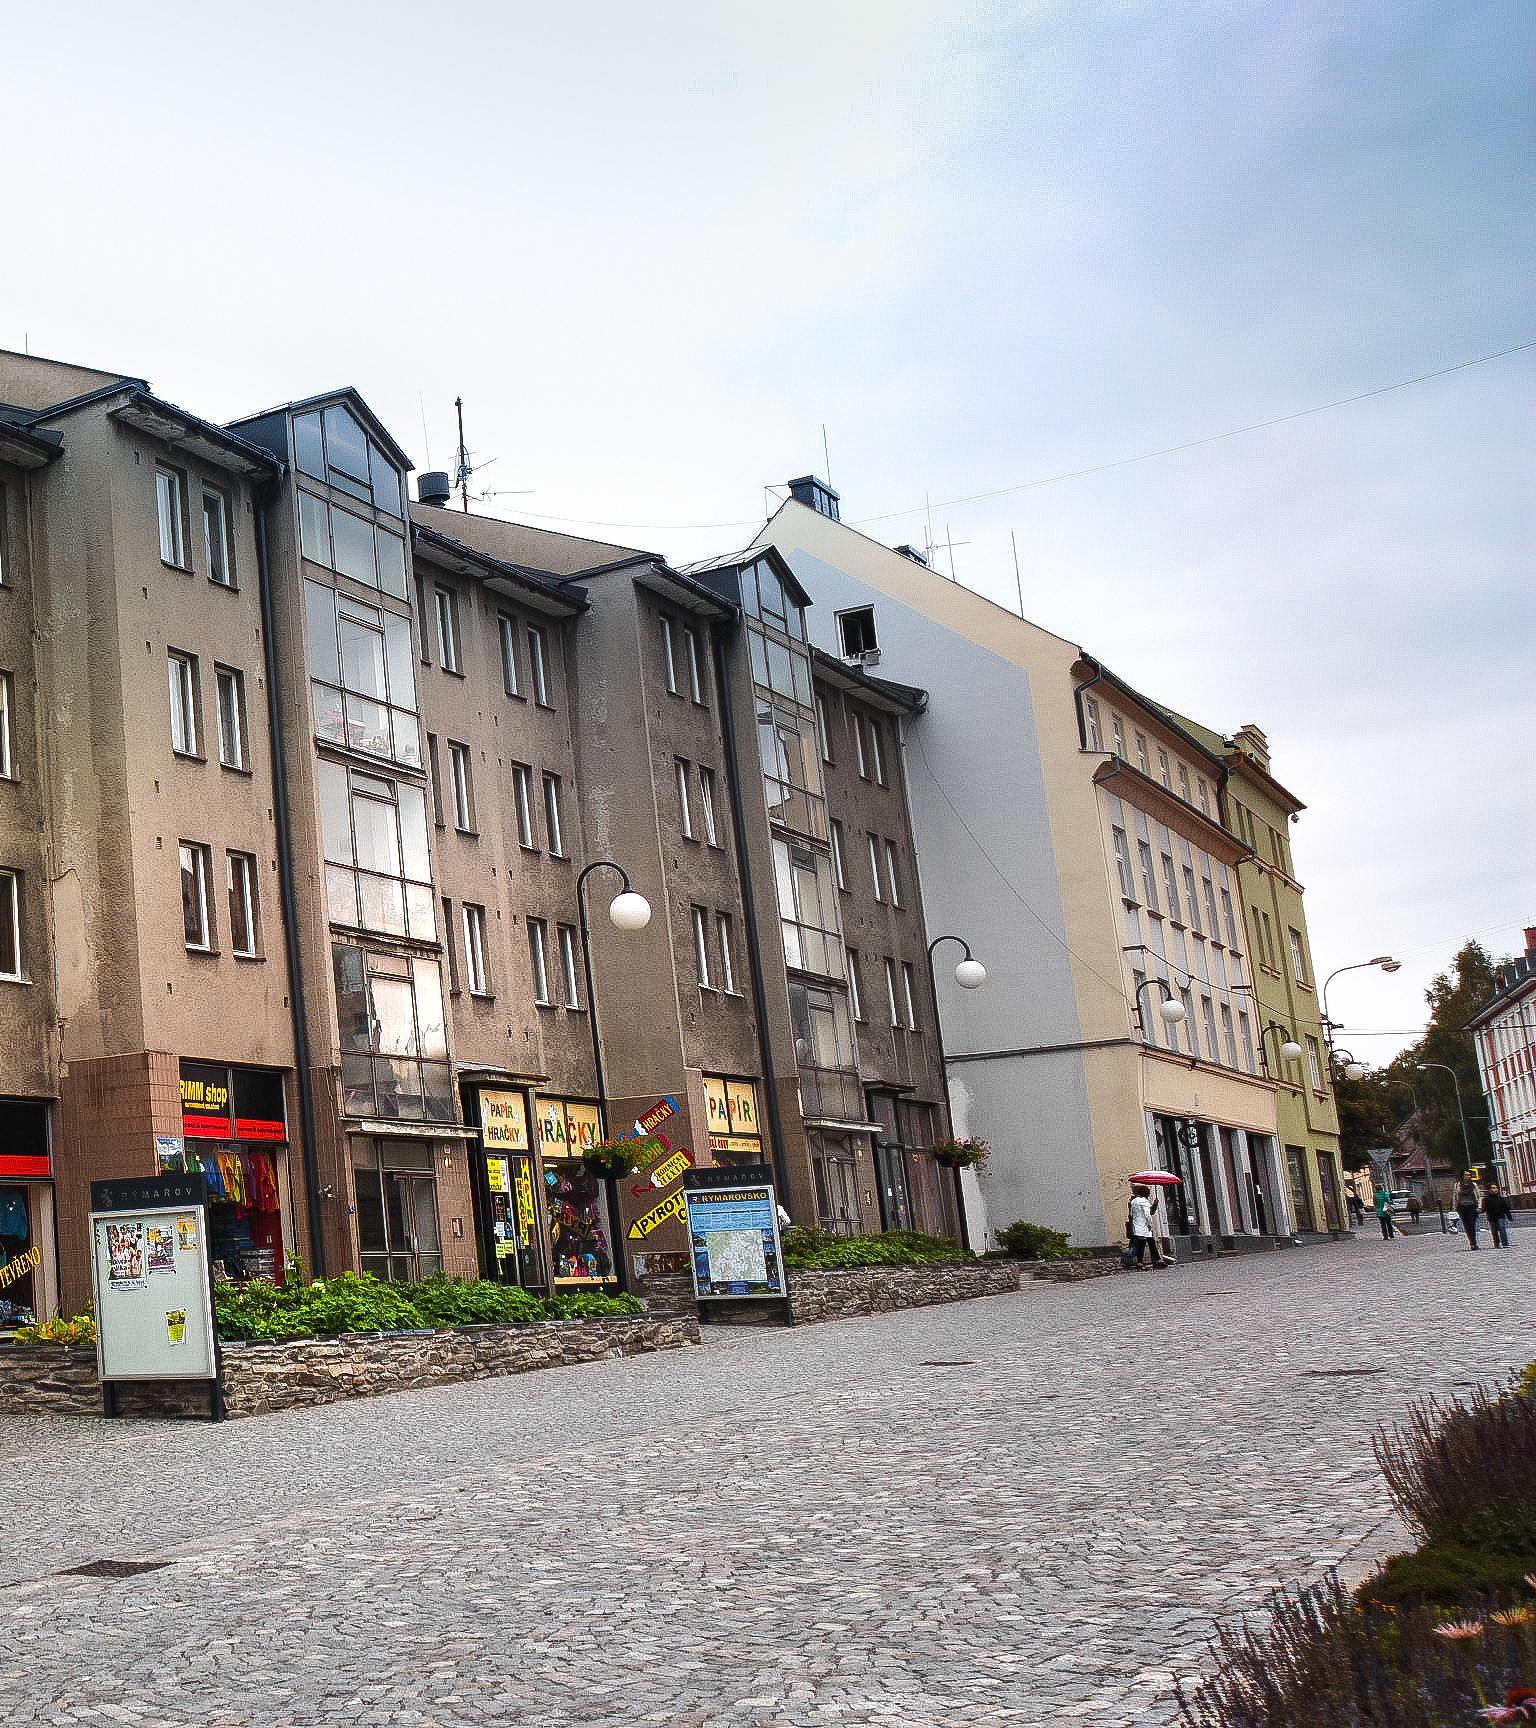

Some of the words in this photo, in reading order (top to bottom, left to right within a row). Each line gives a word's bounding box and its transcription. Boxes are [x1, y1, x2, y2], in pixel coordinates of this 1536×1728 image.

[179, 1079, 204, 1101] RIMM
[206, 1082, 228, 1108] shop
[490, 1101, 514, 1119] PAPÍR
[487, 1124, 520, 1143] HRAČKY
